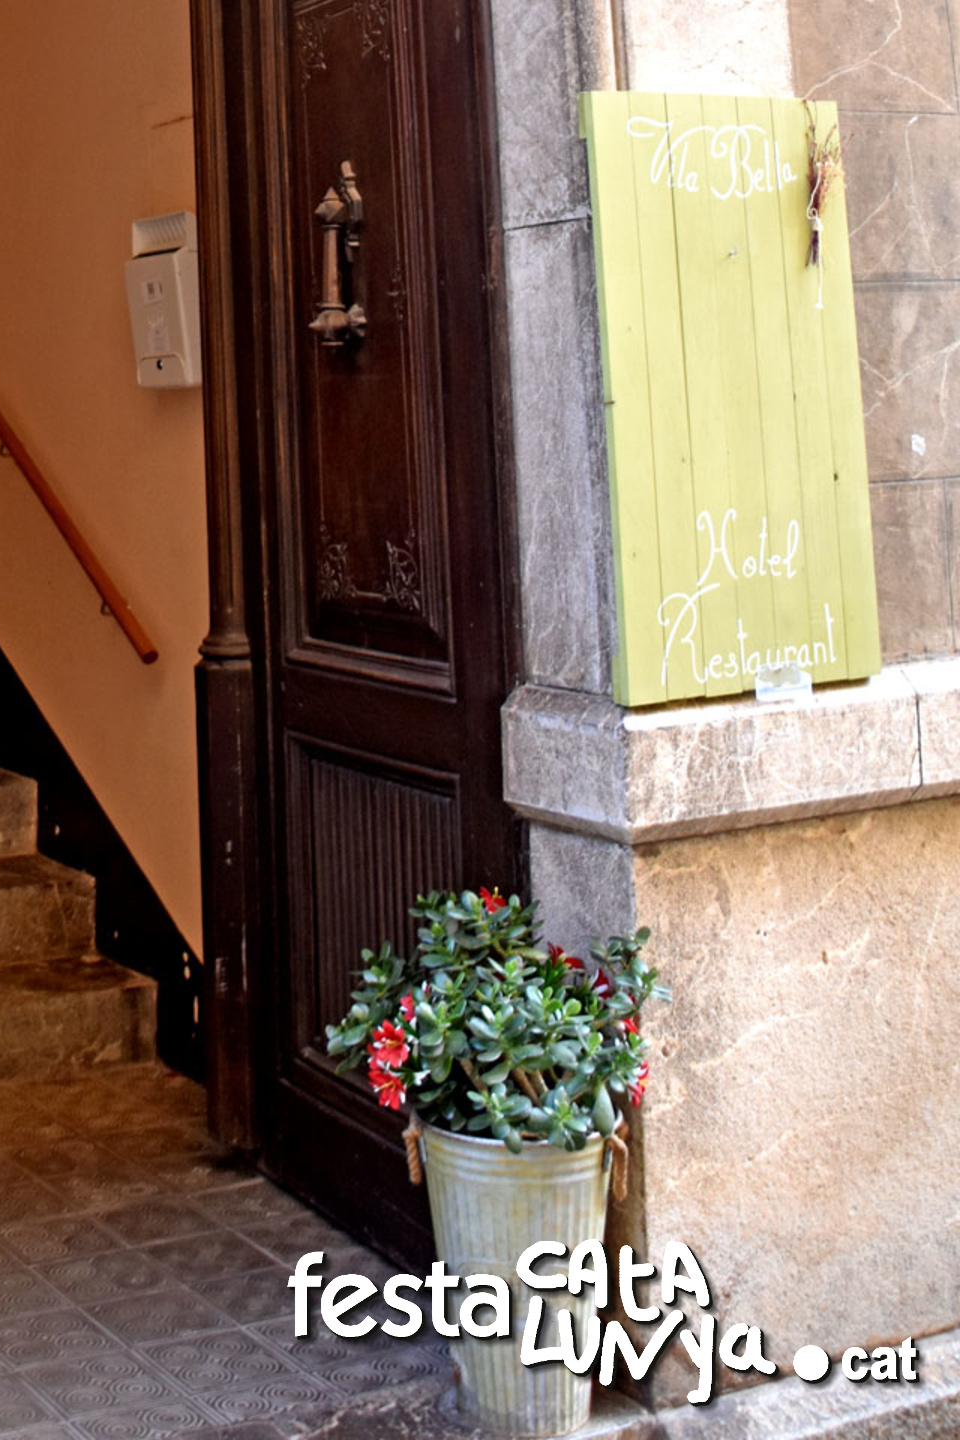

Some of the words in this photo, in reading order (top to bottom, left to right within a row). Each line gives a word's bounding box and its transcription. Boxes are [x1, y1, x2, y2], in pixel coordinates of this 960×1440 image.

[710, 124, 797, 200] Bella
[696, 508, 799, 586] Hotel
[657, 582, 836, 686] Restaurant
